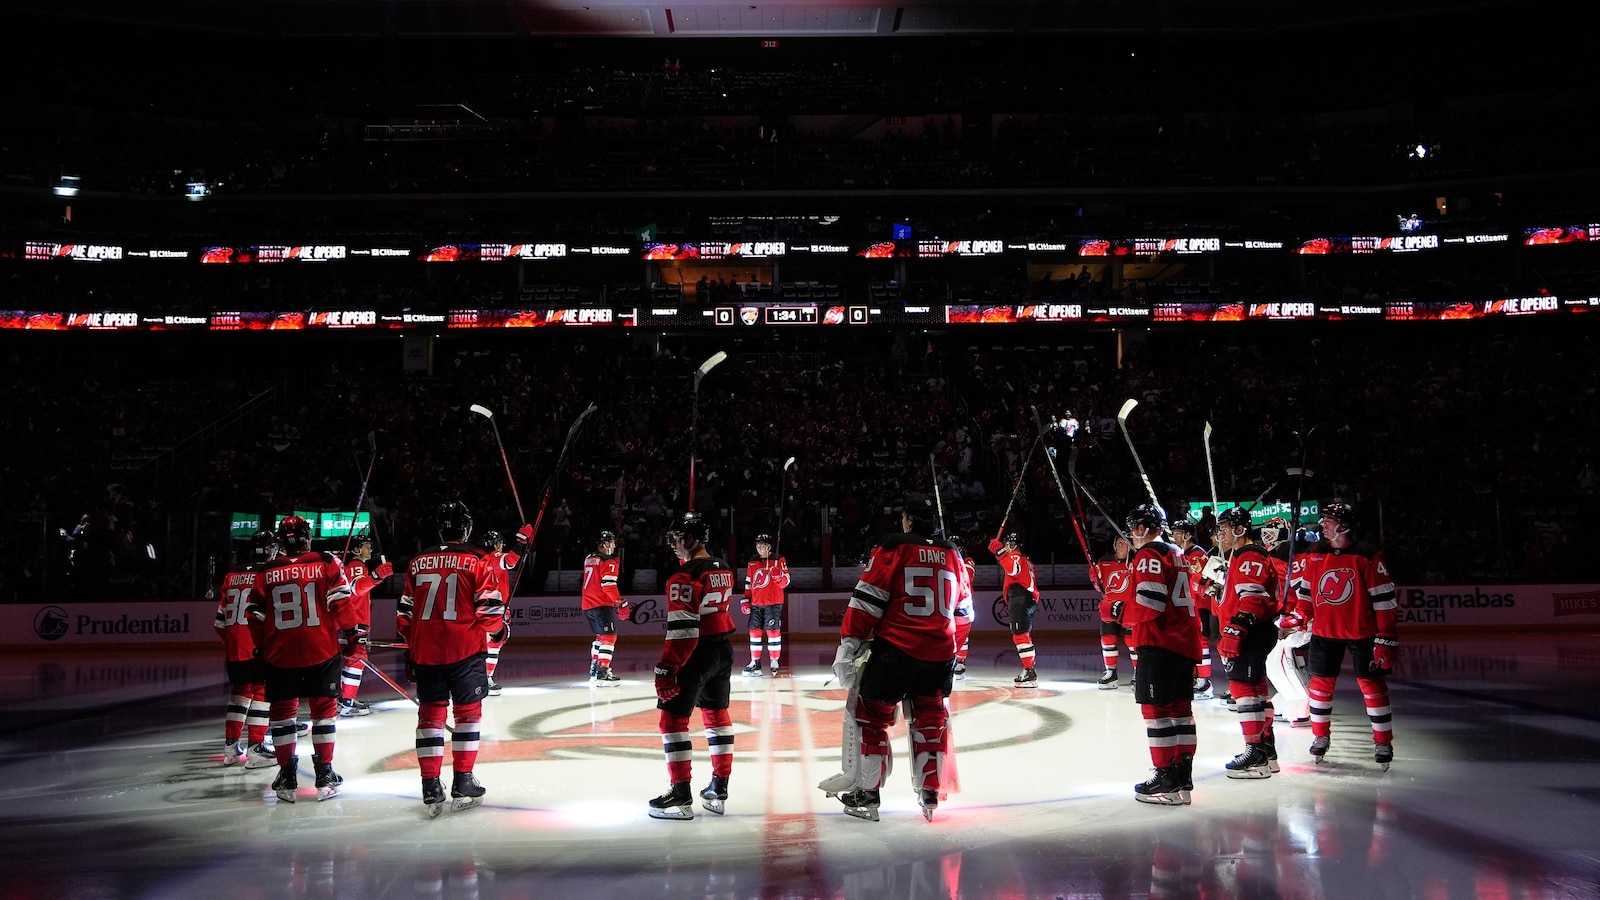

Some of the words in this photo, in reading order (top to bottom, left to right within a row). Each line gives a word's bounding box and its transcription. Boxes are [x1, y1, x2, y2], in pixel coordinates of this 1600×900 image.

[1405, 235, 1438, 249] OPENER
[1475, 234, 1508, 242] Citizens
[534, 244, 566, 257] OPENER
[754, 242, 785, 255] OPENER
[972, 241, 1003, 253] OPENER
[1036, 243, 1066, 251] Citizens
[1189, 238, 1220, 251] OPENER
[88, 246, 122, 259] OPENER
[158, 250, 188, 258] Citizens
[314, 246, 346, 258] OPENER
[1280, 303, 1314, 316] OPENER
[1350, 306, 1381, 314] Citizens
[1519, 297, 1558, 311] OPENER
[578, 309, 612, 322] OPENER
[720, 312, 728, 321] 0
[773, 310, 796, 320] 1:34
[853, 310, 862, 320] 0
[1049, 304, 1081, 317] OPENER
[1117, 308, 1149, 316] Citizens
[1153, 308, 1182, 316] DEVILS
[1387, 307, 1413, 315] DEVILS
[103, 314, 138, 326] OPENER
[174, 317, 206, 325] Citizens
[211, 316, 240, 325] DEVILS
[342, 311, 376, 324] OPENER
[412, 314, 444, 322] Citizens
[449, 314, 478, 322] DEVILS
[919, 549, 946, 565] DAWS
[350, 566, 363, 577] 13
[608, 564, 615, 572] 7
[1136, 558, 1162, 574] 48
[1238, 560, 1263, 576] 47
[229, 574, 256, 586] HUGHE
[265, 564, 323, 585] GRITSYUK
[584, 567, 593, 589] 7
[709, 574, 731, 587] BRATT
[416, 573, 458, 620] 71
[670, 583, 693, 603] 63
[903, 567, 957, 618] 50
[271, 581, 321, 630] 81
[1560, 598, 1596, 609] MIKE'S
[75, 613, 190, 634] Prudential
[1048, 614, 1093, 622] COMPANY
